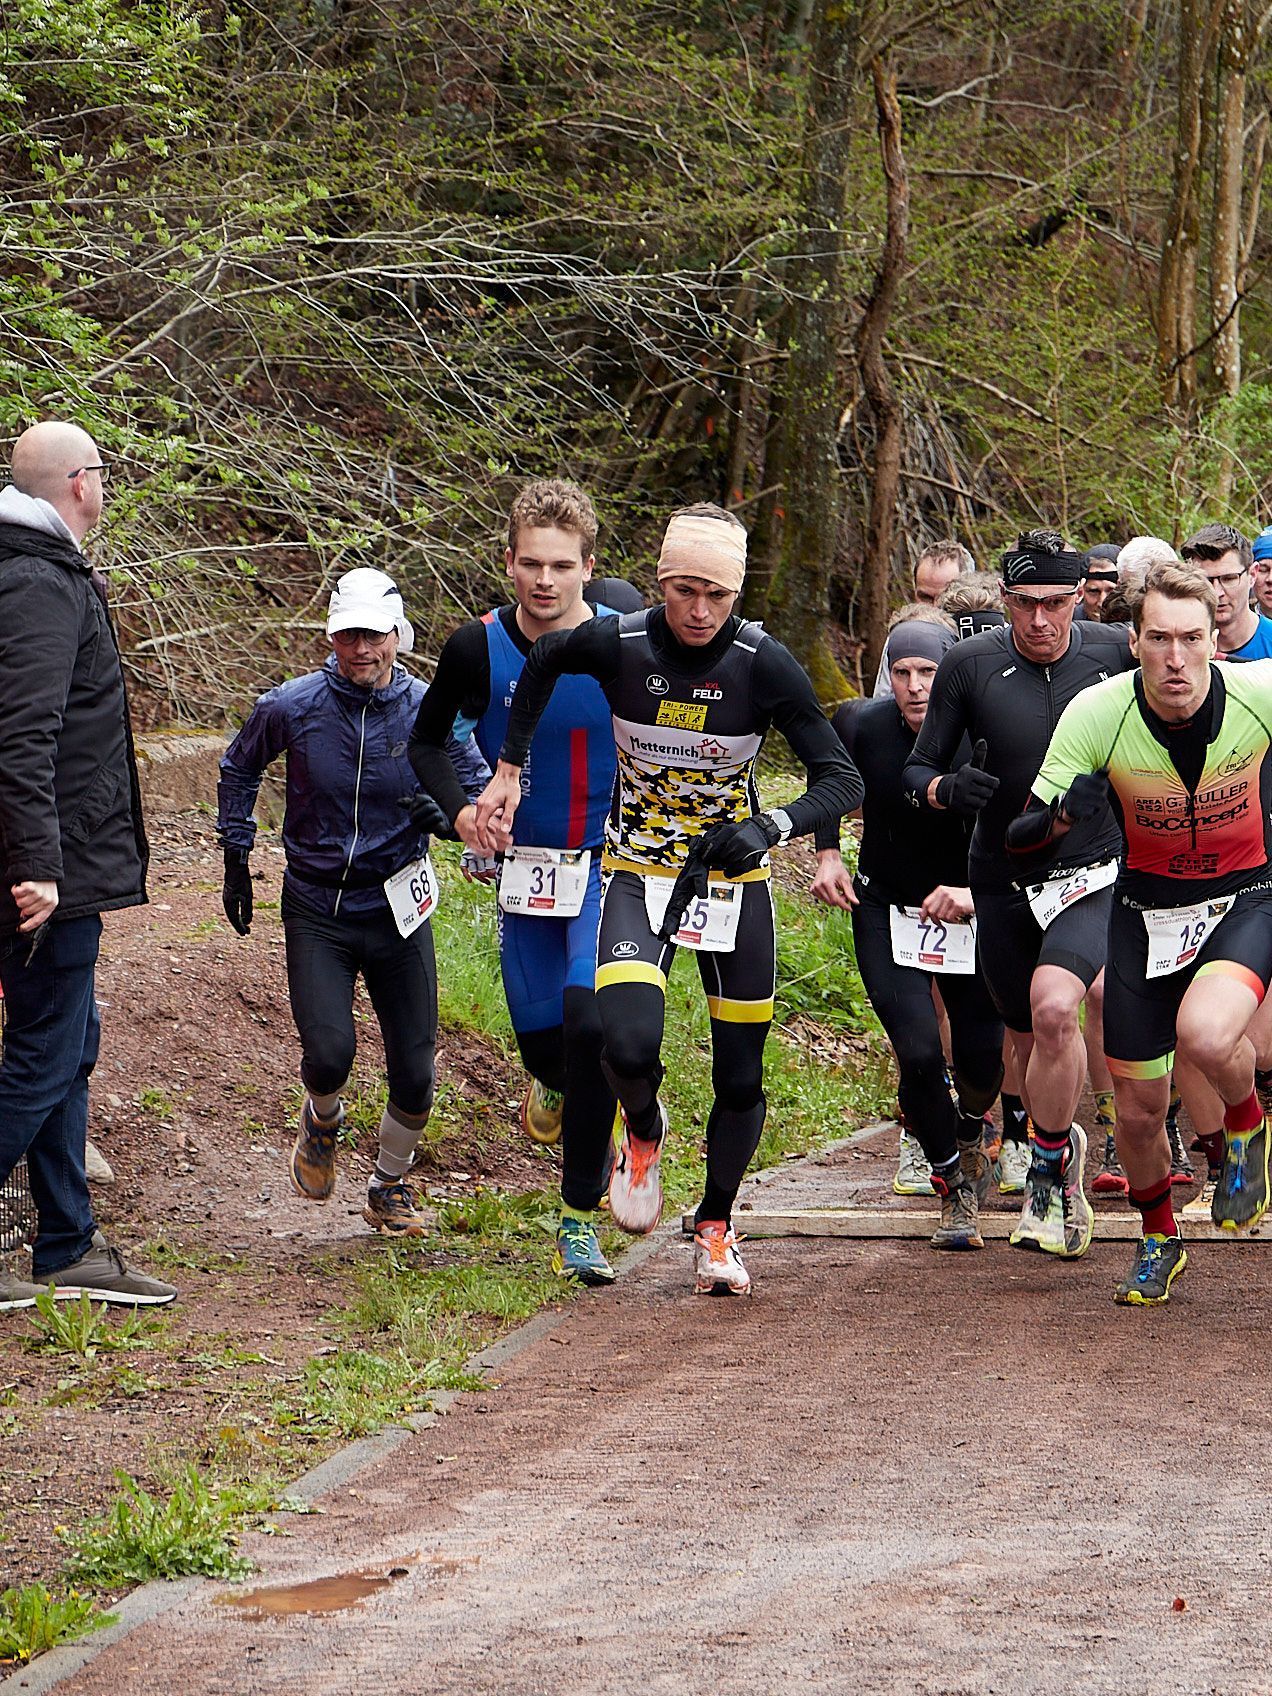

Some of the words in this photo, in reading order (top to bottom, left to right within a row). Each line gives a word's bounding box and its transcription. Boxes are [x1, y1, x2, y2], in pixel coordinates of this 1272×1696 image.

[693, 689, 723, 700] FELD
[629, 735, 699, 759] Metternich
[1135, 797, 1250, 832] BoConcept
[1136, 804, 1163, 813] 352
[410, 870, 430, 904] 68
[529, 866, 556, 896] 31
[1058, 873, 1088, 898] 25
[918, 924, 947, 952] 72
[1180, 921, 1206, 951] 18
